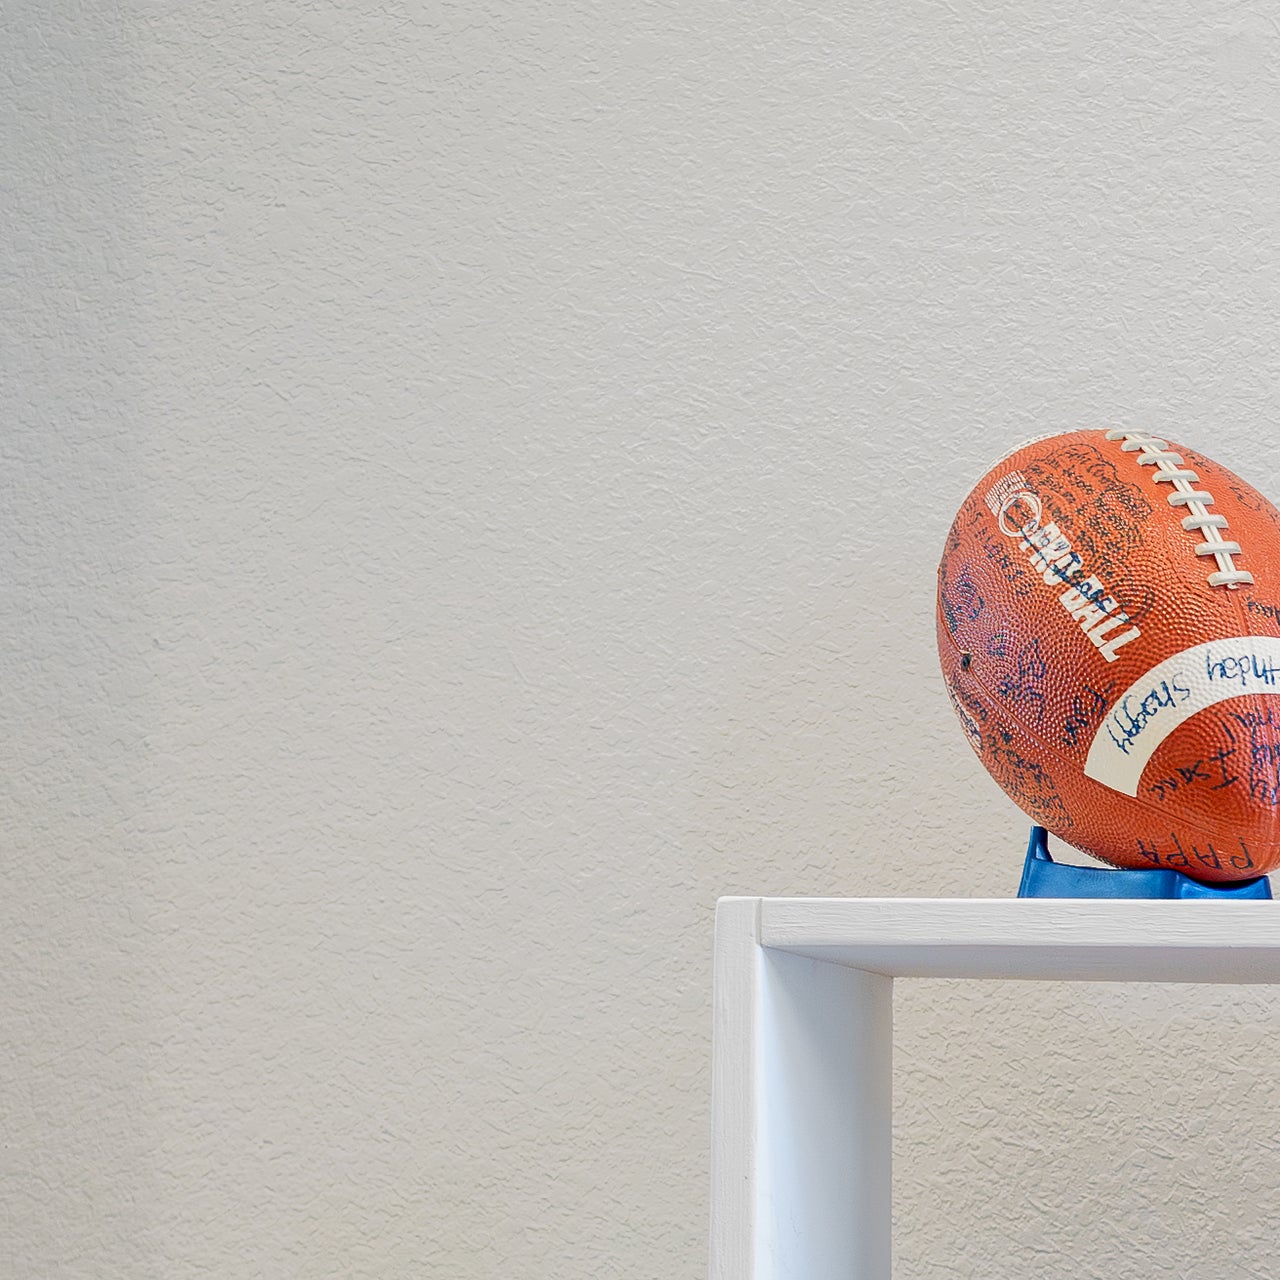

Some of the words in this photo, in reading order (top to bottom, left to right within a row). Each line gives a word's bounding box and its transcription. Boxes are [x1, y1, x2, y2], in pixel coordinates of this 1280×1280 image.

[1020, 521, 1083, 586] PRO
[1059, 574, 1141, 663] BALL
[1136, 832, 1253, 870] PAPA
